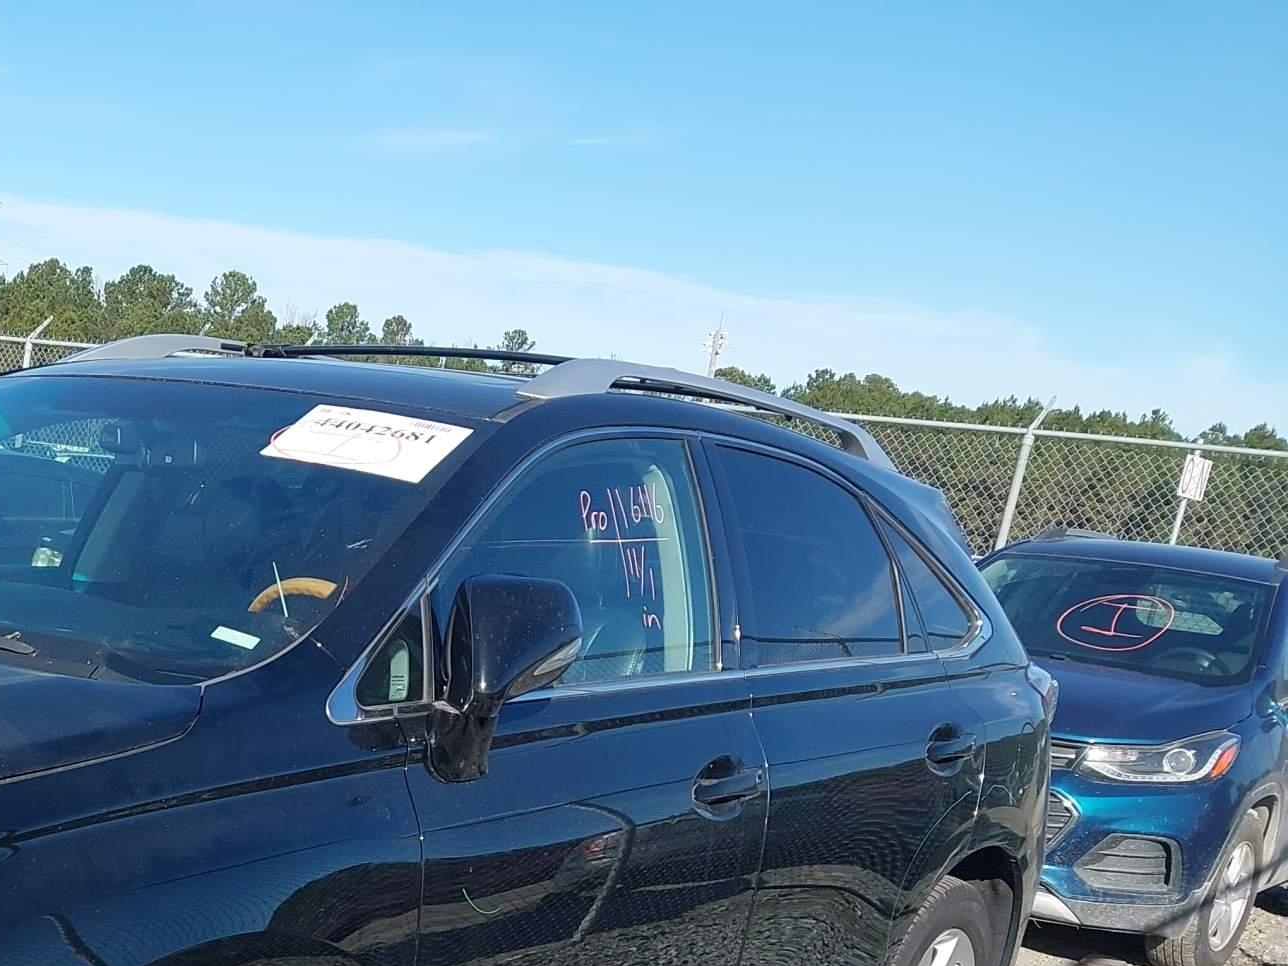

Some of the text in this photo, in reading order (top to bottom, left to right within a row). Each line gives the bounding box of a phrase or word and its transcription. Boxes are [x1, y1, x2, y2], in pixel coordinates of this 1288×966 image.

[314, 417, 438, 444] 44042681
[580, 490, 608, 531] Pro
[642, 605, 662, 630] in
